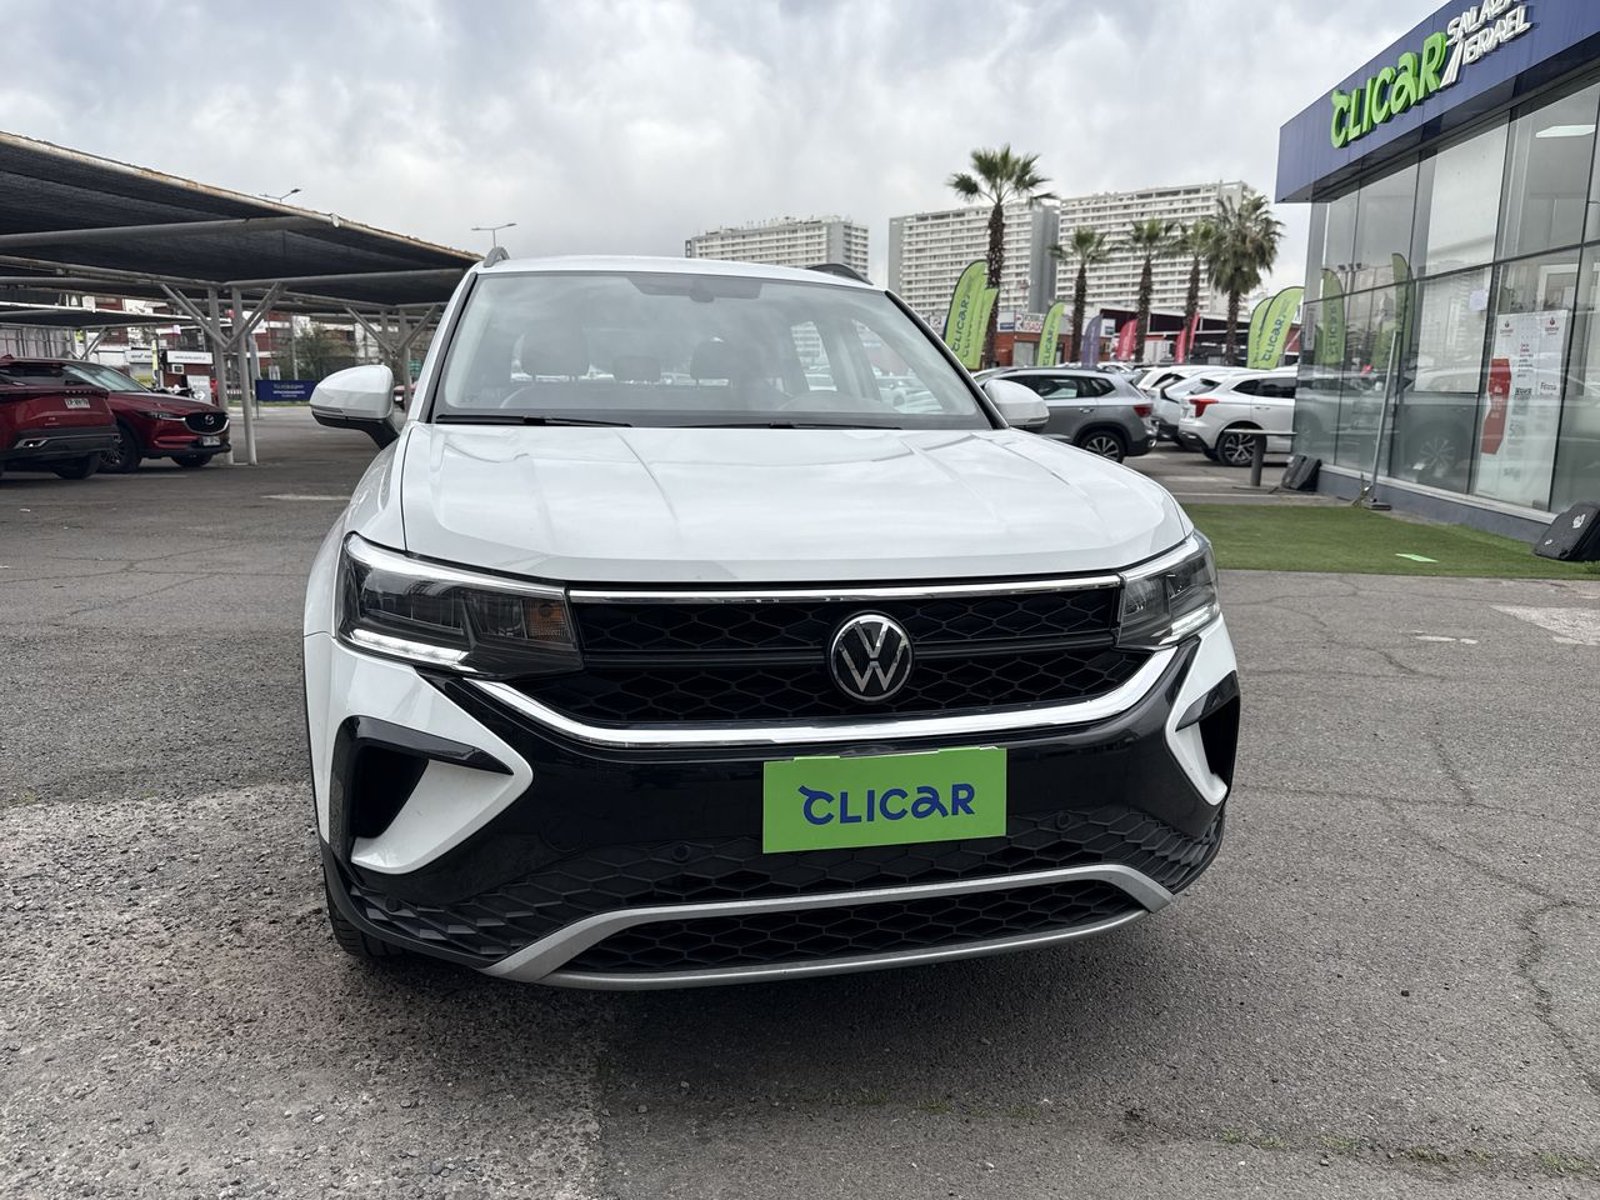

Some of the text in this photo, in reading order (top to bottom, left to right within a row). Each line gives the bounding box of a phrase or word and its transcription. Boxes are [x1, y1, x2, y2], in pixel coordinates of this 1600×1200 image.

[1330, 32, 1448, 149] CLICAR
[1260, 319, 1284, 361] CLICAR
[798, 783, 976, 826] CLICAR
